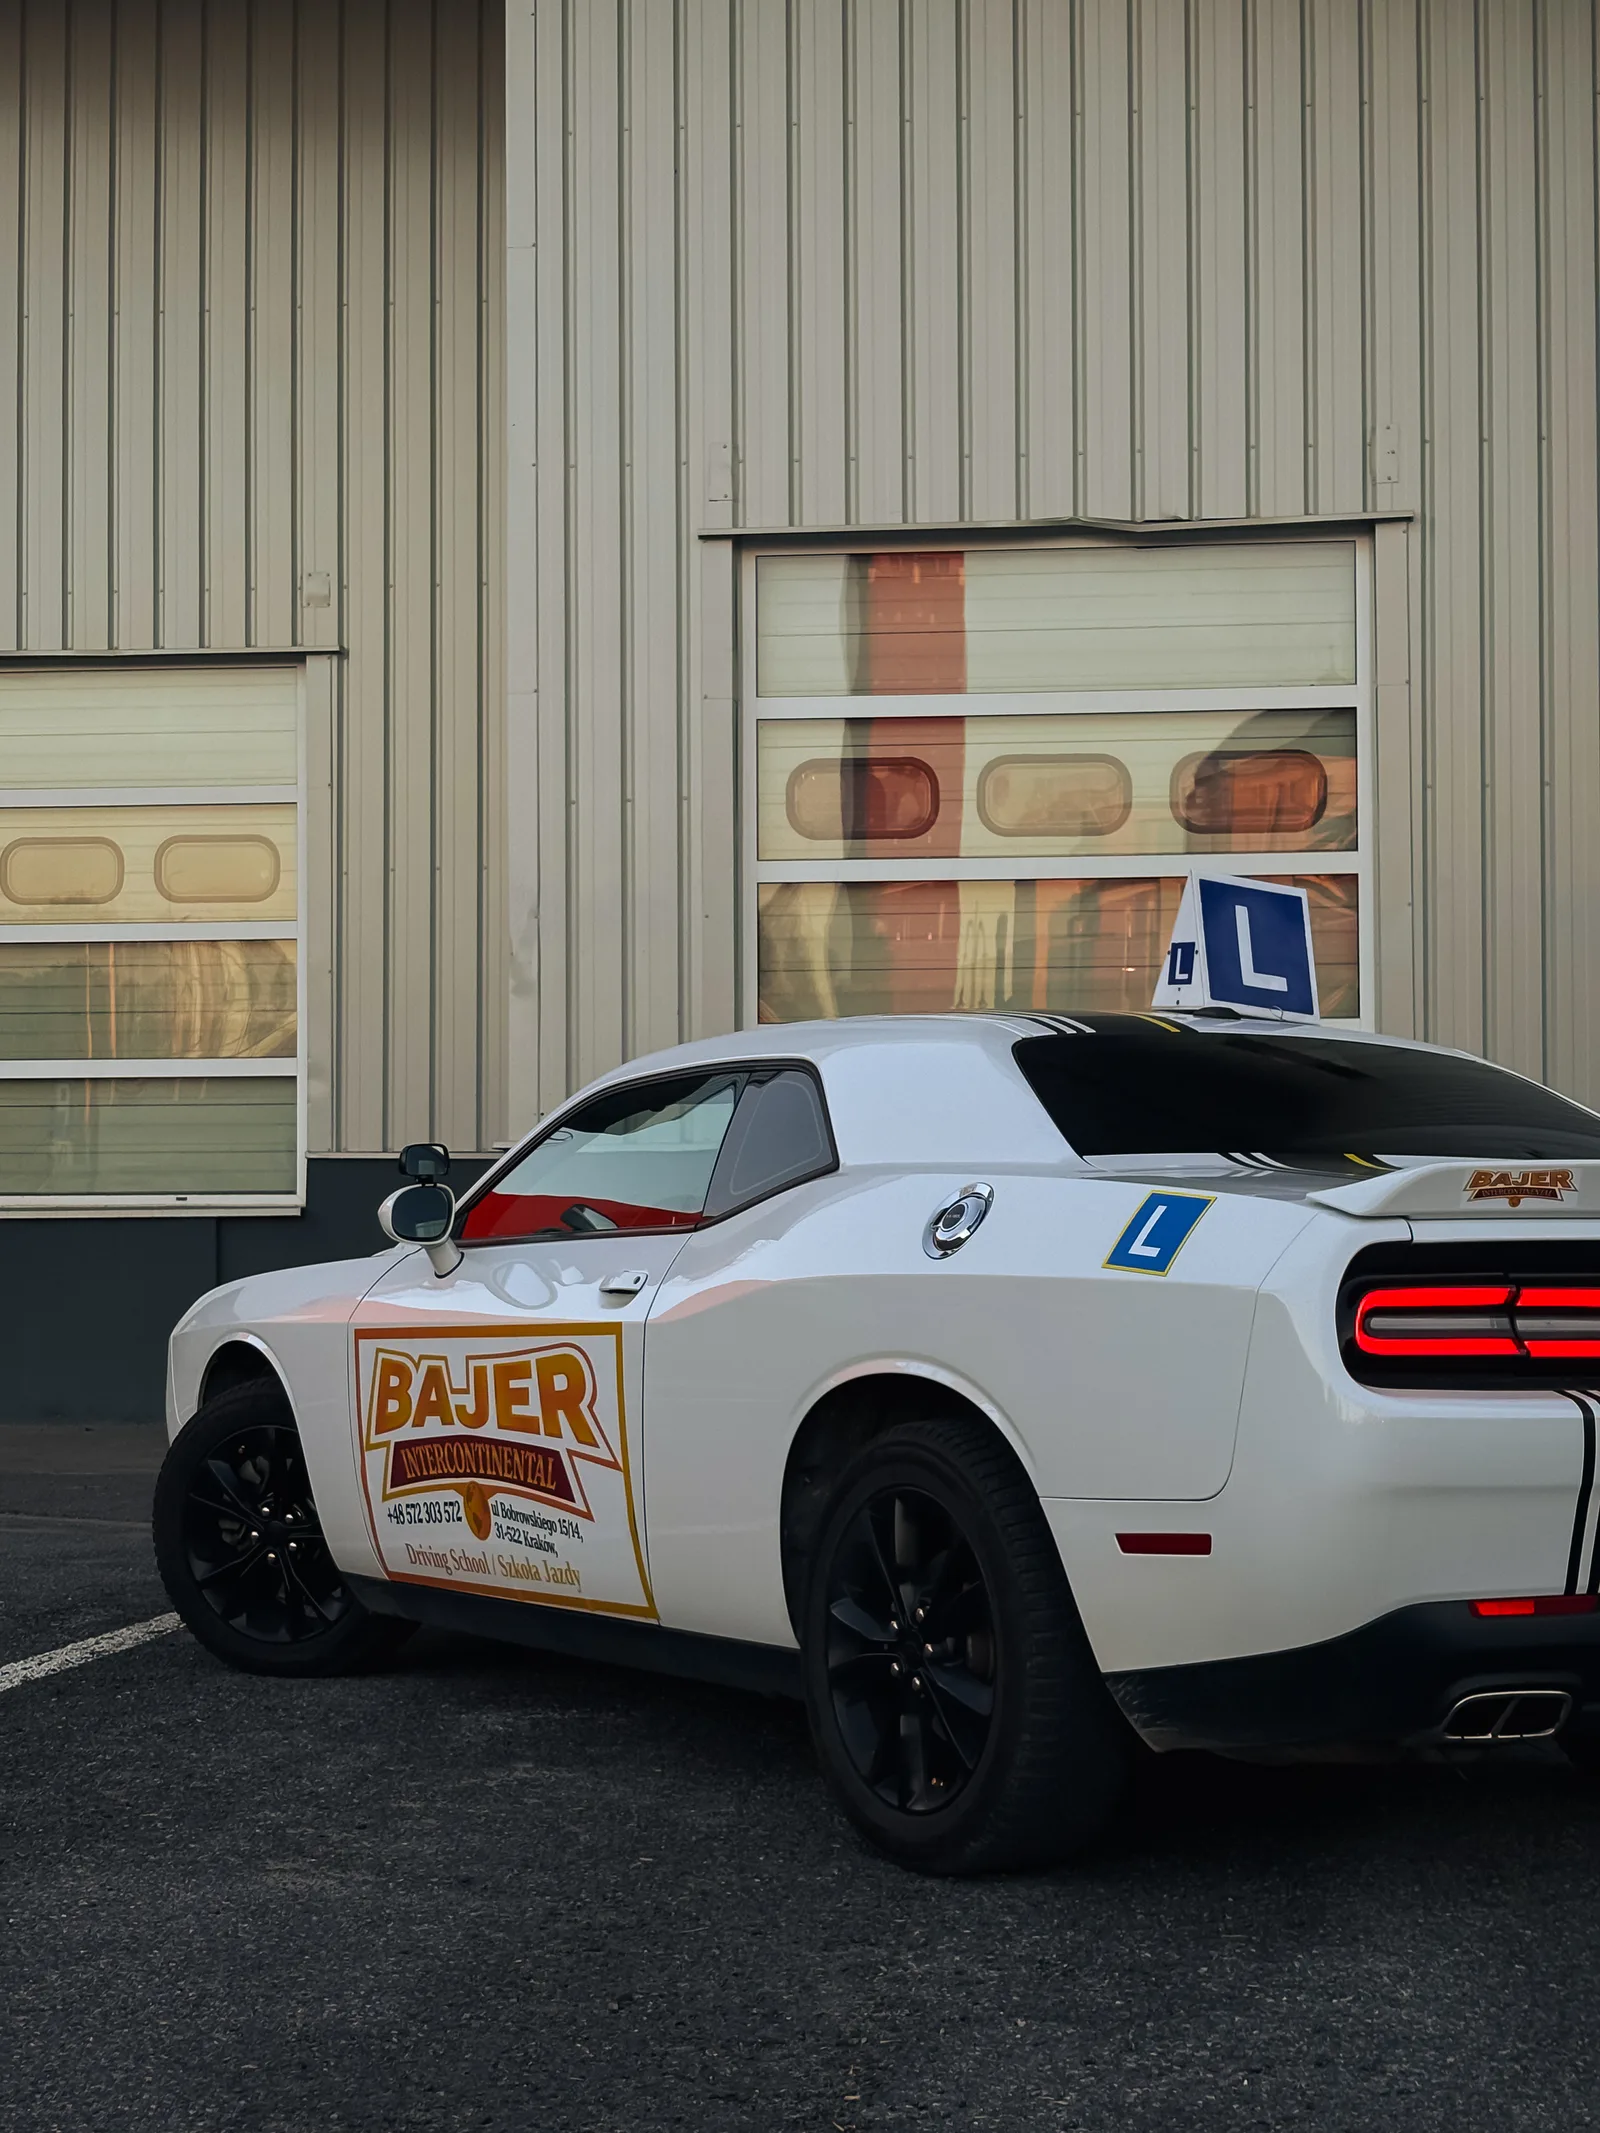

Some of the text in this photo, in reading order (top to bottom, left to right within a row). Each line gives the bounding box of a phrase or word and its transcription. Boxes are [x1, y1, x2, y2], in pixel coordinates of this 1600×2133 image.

[1174, 948, 1189, 980] L
[1234, 904, 1288, 992] L
[1468, 1169, 1573, 1189] BAJER
[1128, 1205, 1168, 1258] L
[375, 1353, 600, 1448] BAJER
[400, 1440, 557, 1490] INTERCONTINENTAL
[387, 1500, 463, 1525] +48 572 303 572
[499, 1501, 558, 1537] Bobrowskiego
[558, 1517, 584, 1543] 15/14,
[494, 1521, 559, 1558] 31-522 Kraków,
[404, 1542, 453, 1577] Driving
[449, 1548, 491, 1575] School
[542, 1559, 582, 1593] Jazdy
